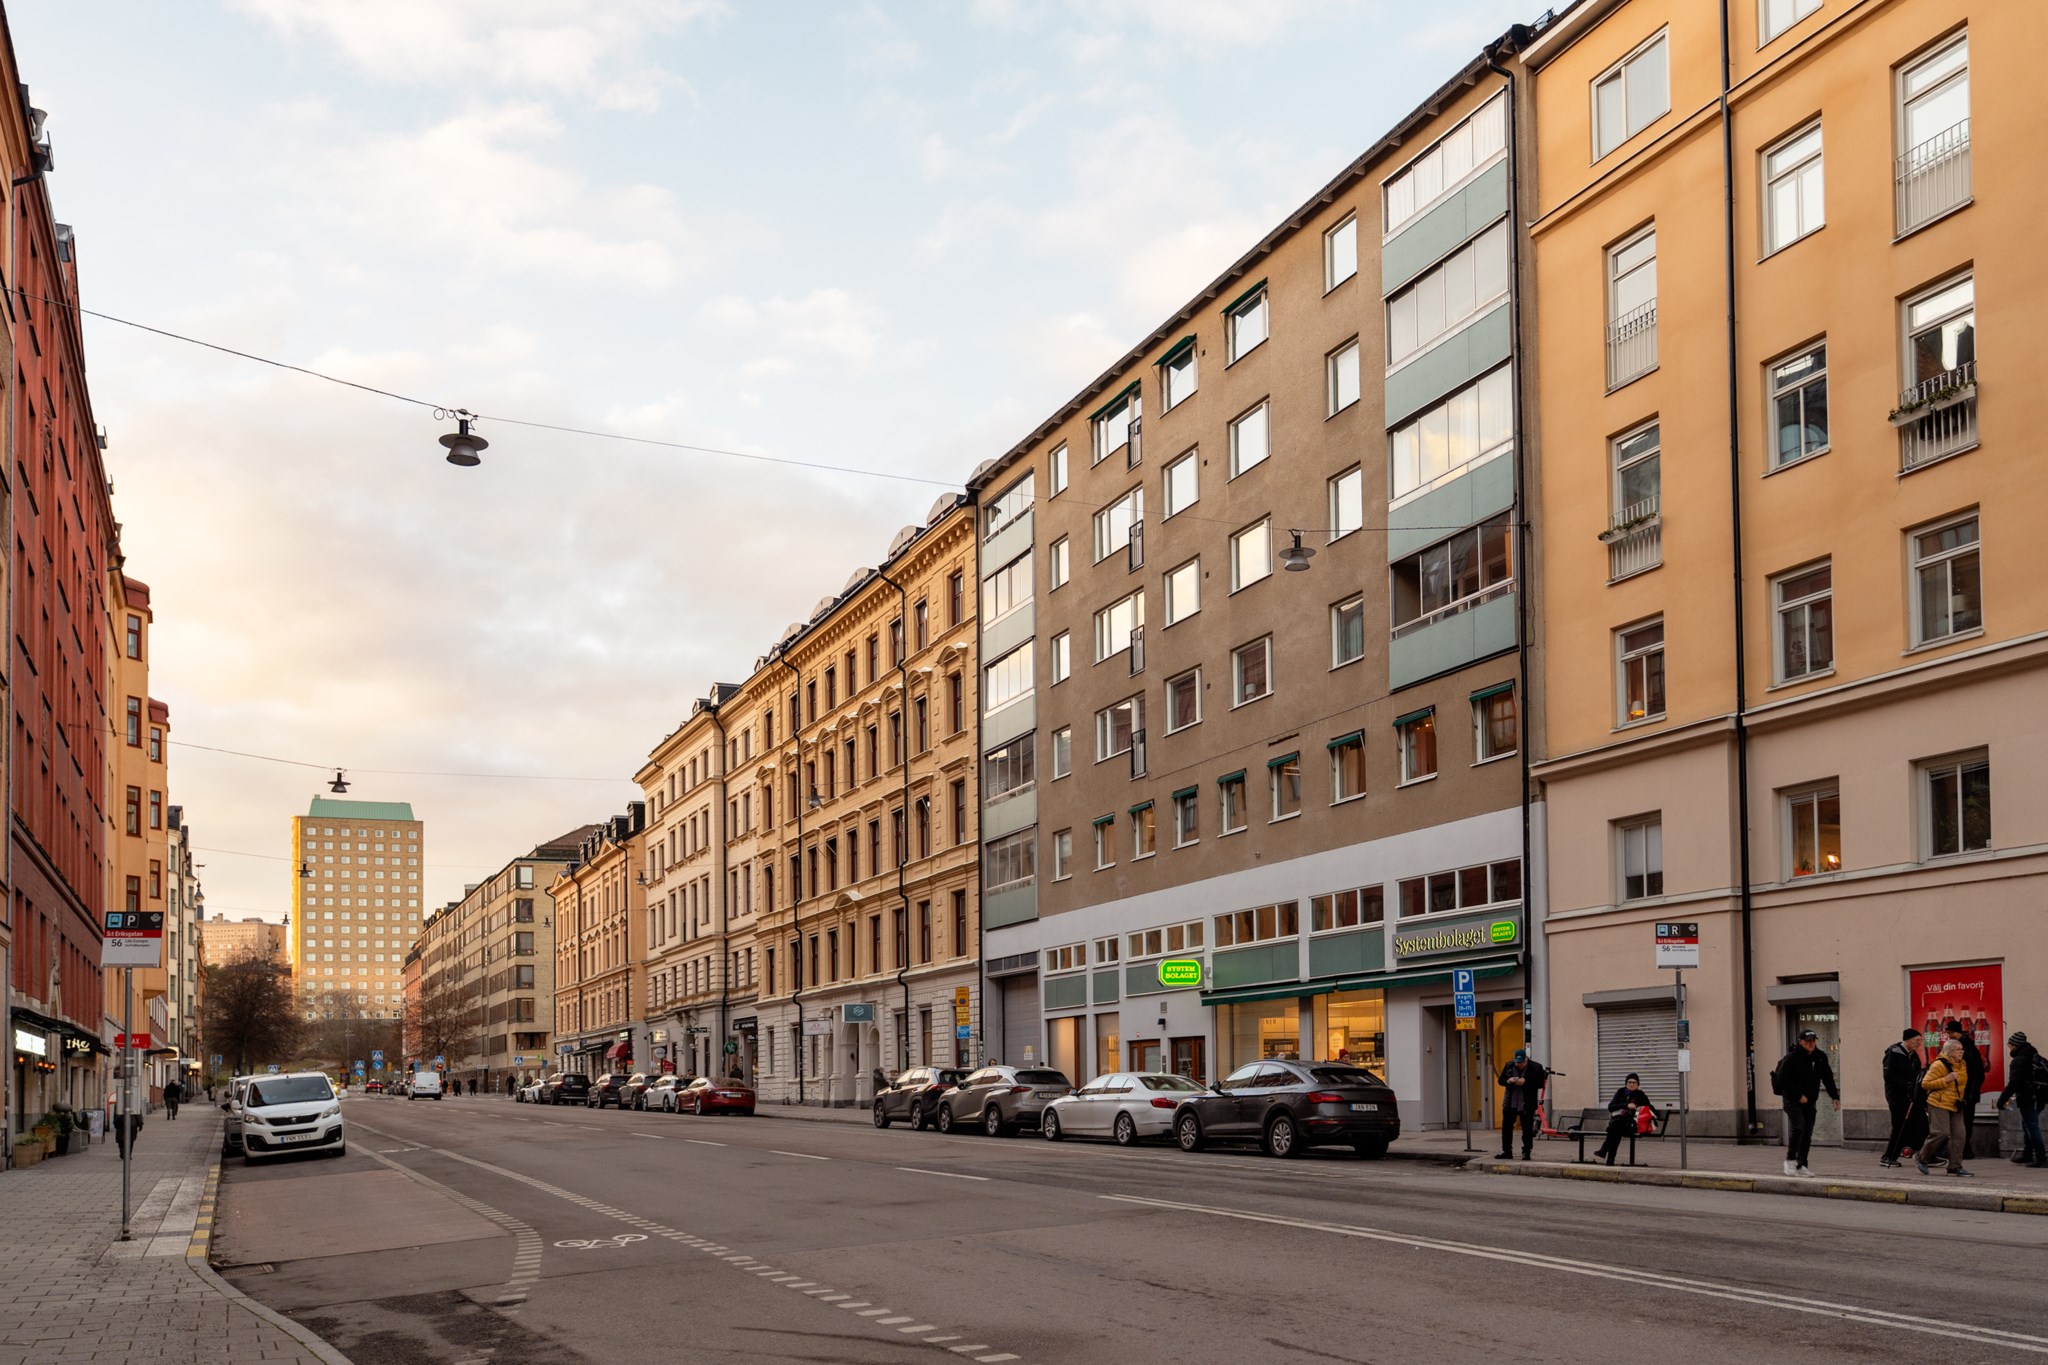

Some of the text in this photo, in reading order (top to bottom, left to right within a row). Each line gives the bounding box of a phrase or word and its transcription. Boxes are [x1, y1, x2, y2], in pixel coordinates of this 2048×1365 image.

[127, 915, 136, 926] P
[1672, 926, 1678, 935] R
[111, 939, 123, 947] 56
[1395, 926, 1486, 957] Systembolaget
[1458, 971, 1470, 991] P
[1926, 983, 1941, 992] Välj
[1958, 981, 1985, 990] favorit
